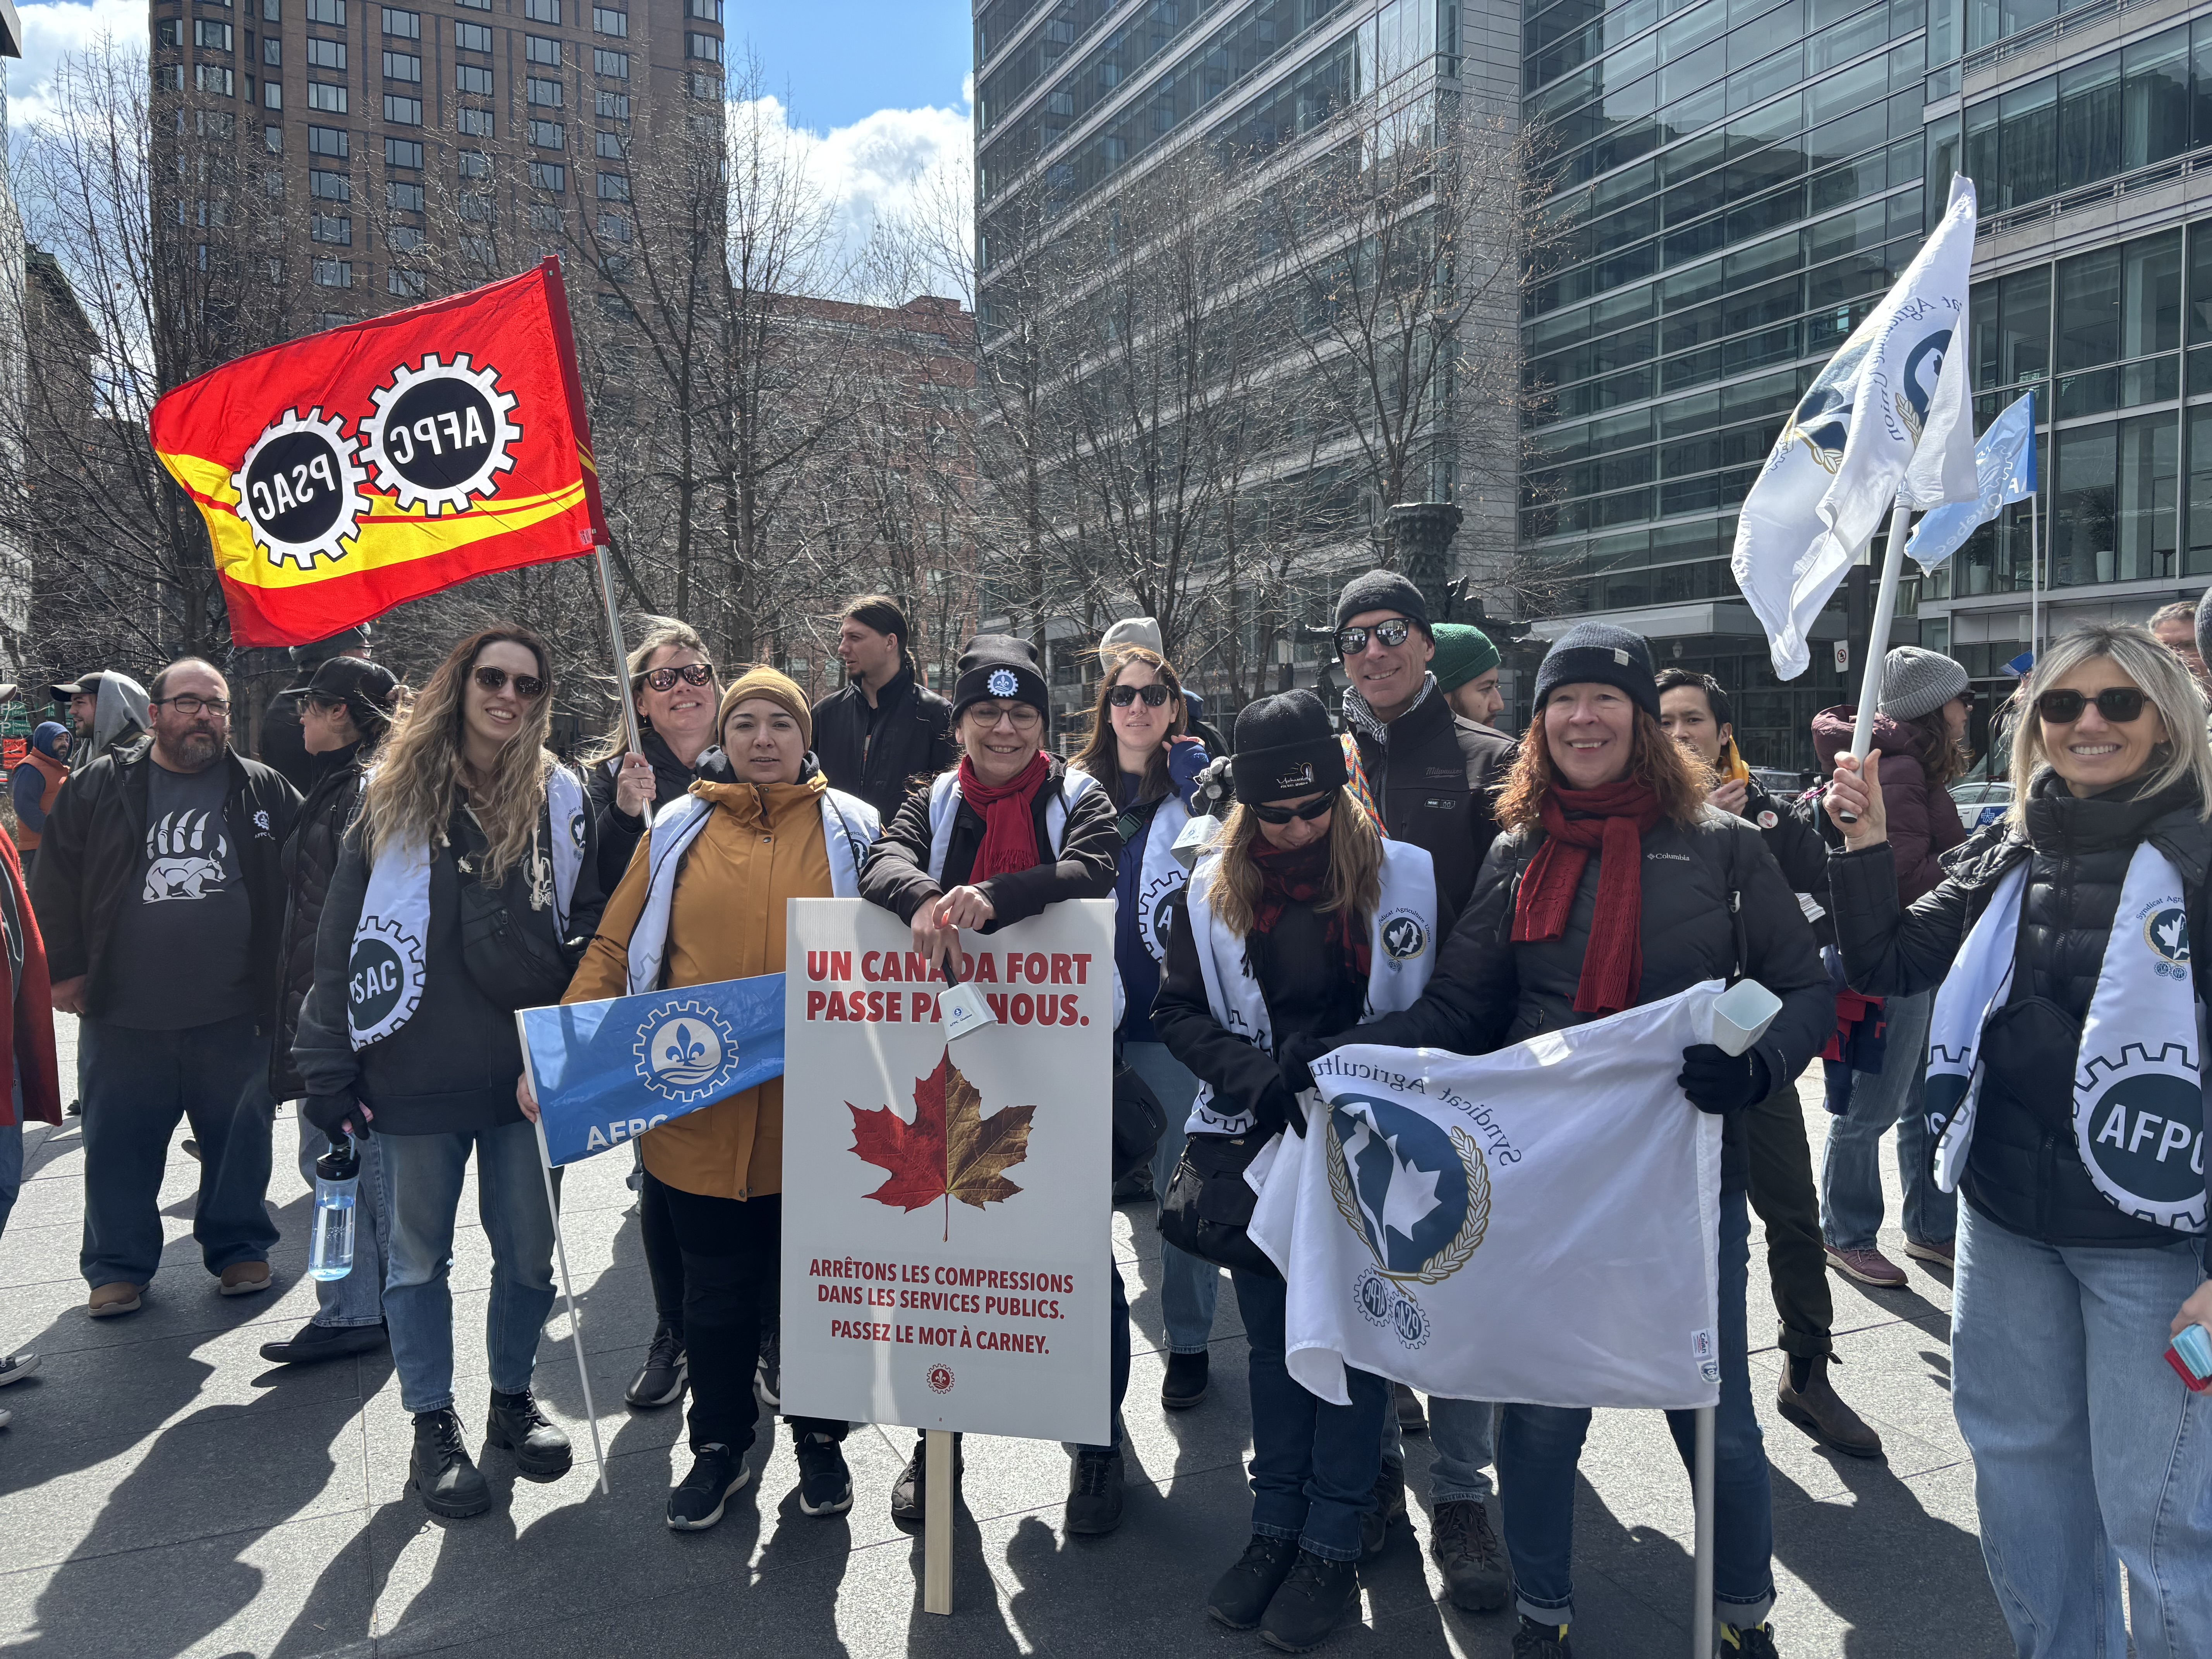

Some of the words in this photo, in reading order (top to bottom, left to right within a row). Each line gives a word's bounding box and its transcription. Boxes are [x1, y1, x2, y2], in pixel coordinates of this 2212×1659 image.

[1656, 853, 1690, 861] Columbia
[1395, 907, 1425, 924] Agriculture
[2136, 898, 2164, 920] Syndicat
[807, 951, 852, 981] UN
[1007, 953, 1092, 984] FORT
[807, 991, 902, 1022] PASSE
[987, 994, 1089, 1026] NOUS.
[809, 1256, 897, 1281] ARRÊTONS
[902, 1265, 930, 1284] LES
[935, 1267, 1073, 1294] COMPRESSIONS
[818, 1285, 863, 1305] DANS
[868, 1288, 896, 1307] LES
[900, 1290, 980, 1314] SERVICES
[986, 1296, 1065, 1319] PUBLICS.
[831, 1320, 891, 1342] PASSEZ
[896, 1325, 914, 1344] LE
[919, 1327, 957, 1347] MOT
[960, 1325, 971, 1349] À
[976, 1331, 1050, 1355] CARNEY.
